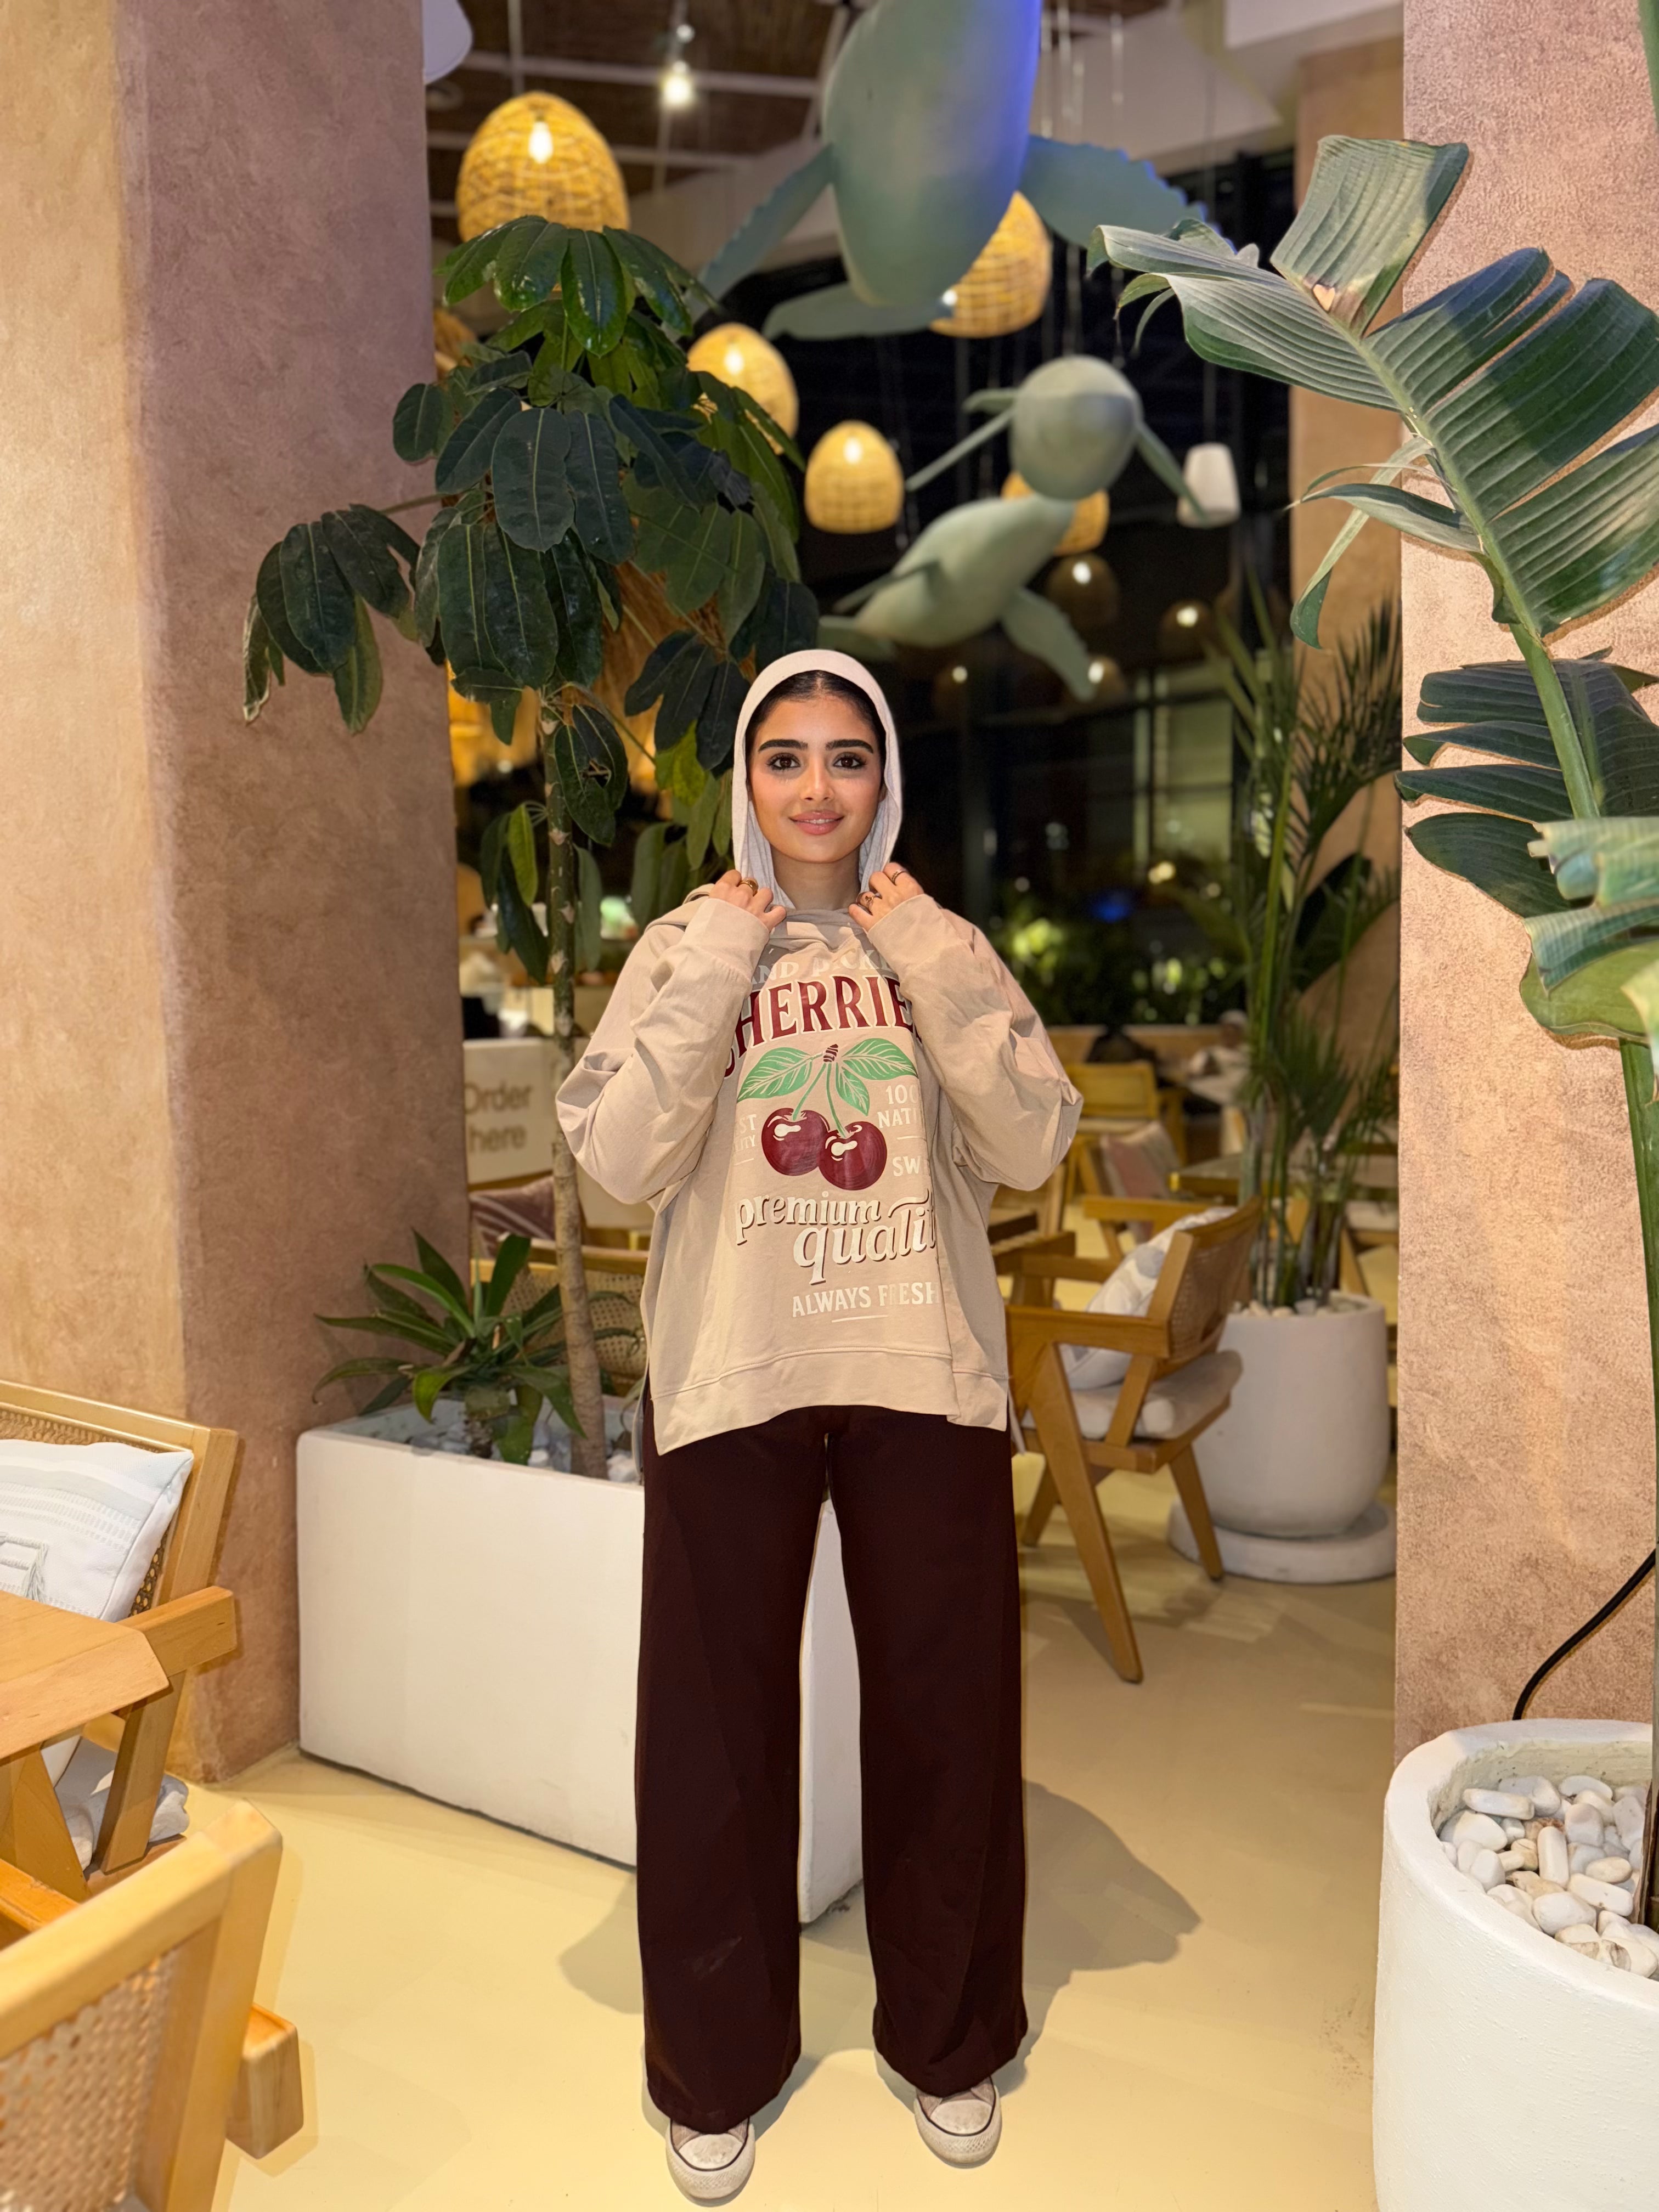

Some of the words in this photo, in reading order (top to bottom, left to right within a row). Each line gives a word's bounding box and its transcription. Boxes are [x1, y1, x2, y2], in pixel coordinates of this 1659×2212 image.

[724, 974, 923, 1077] HERRIE
[735, 1192, 881, 1245] premium
[792, 1286, 871, 1317] ALWAYS
